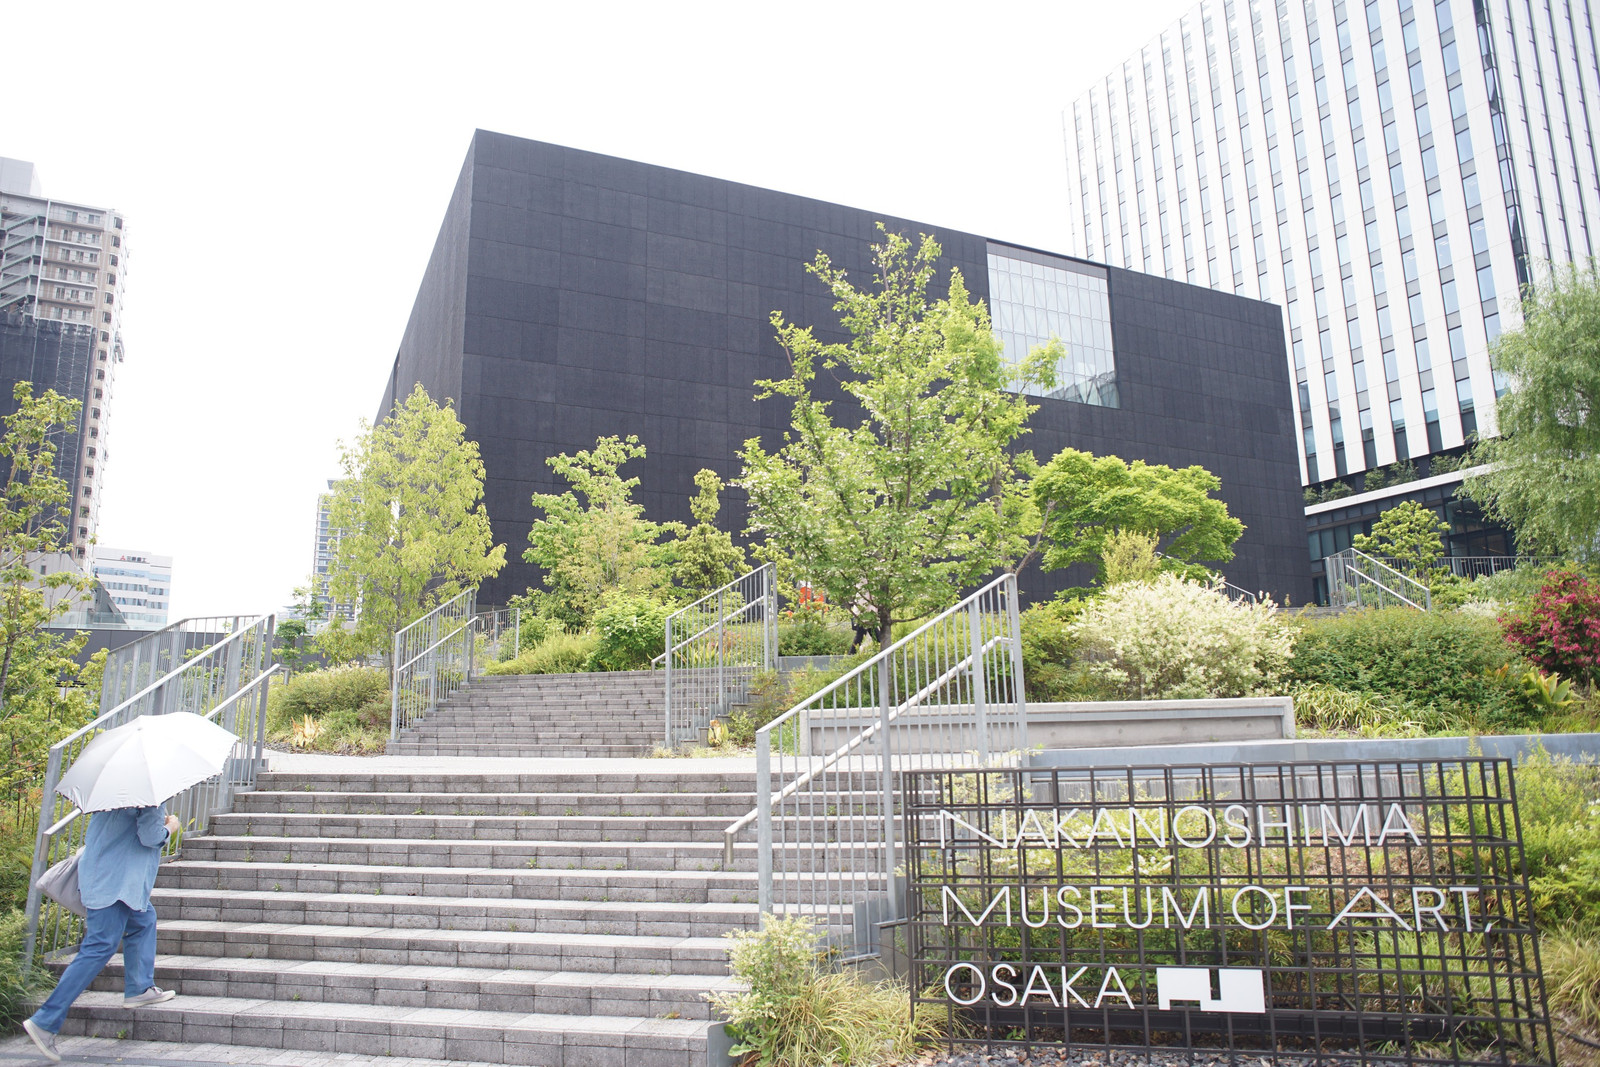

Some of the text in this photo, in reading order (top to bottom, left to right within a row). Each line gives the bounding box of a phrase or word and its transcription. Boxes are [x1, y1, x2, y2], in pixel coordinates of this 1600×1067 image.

[939, 803, 1422, 849] NAKANOSHIMA
[942, 885, 1493, 933] MUSEUM OF ART,
[944, 962, 1136, 1010] OSAKA
